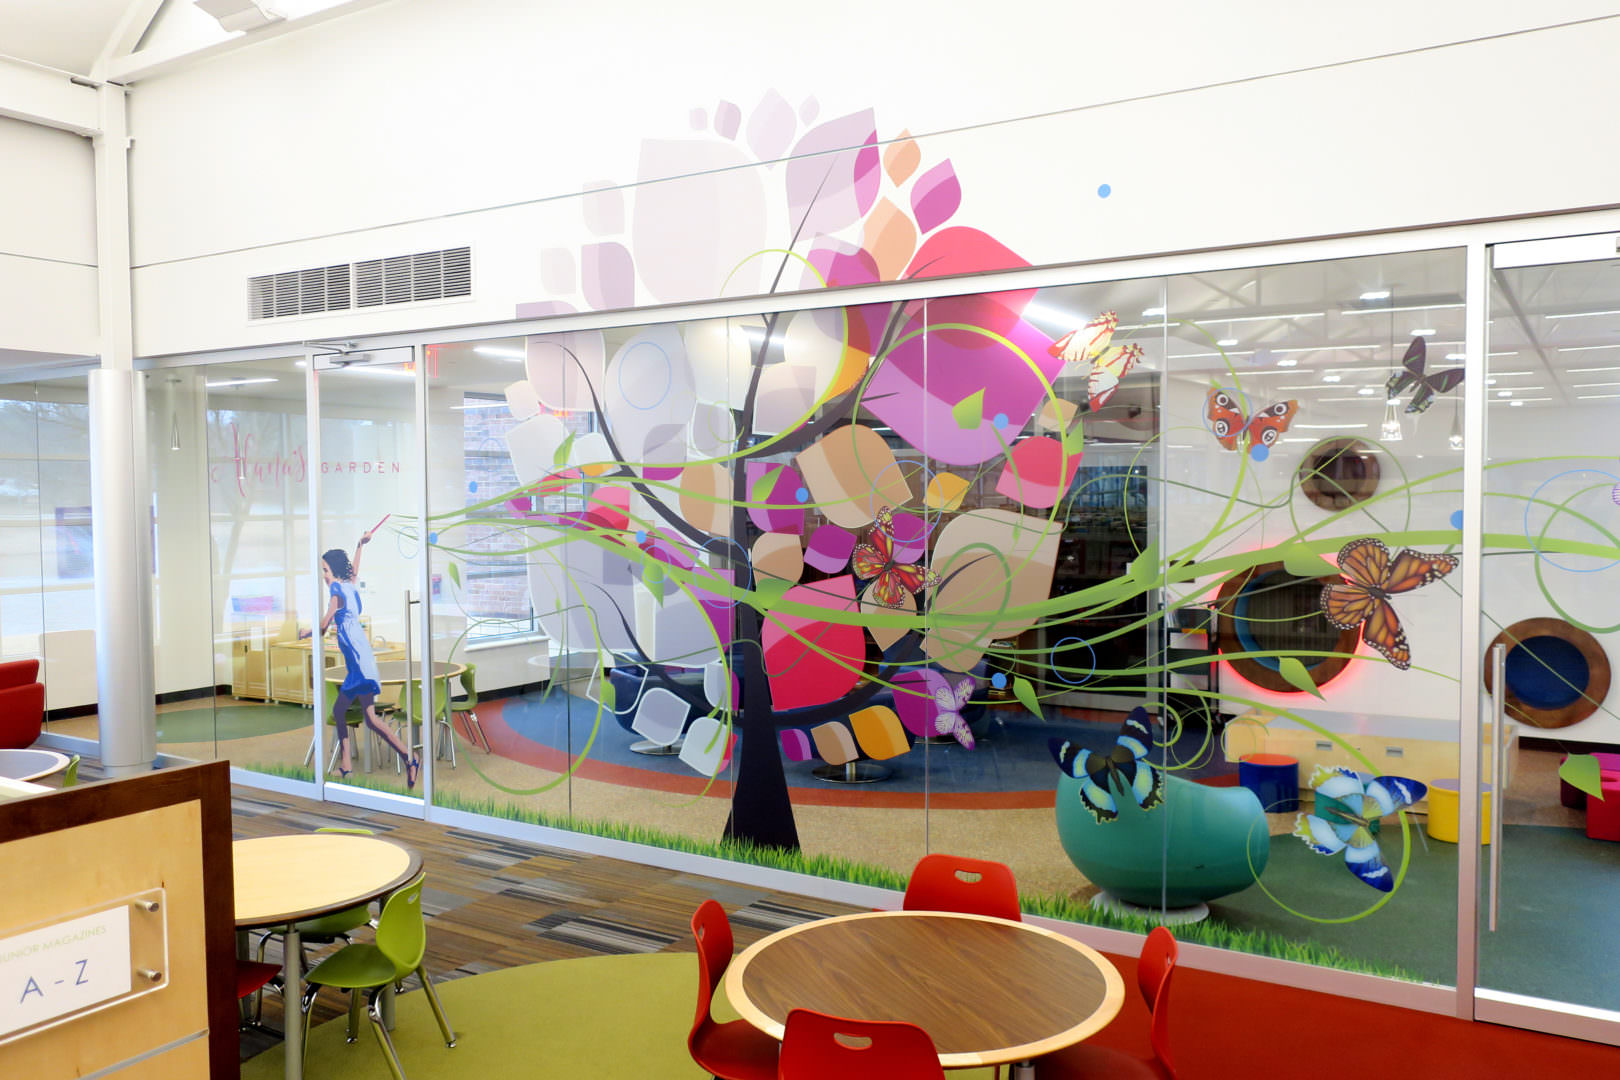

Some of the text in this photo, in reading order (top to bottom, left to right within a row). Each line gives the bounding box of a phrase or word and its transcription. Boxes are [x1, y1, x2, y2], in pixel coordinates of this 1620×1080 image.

[321, 461, 400, 474] GARDEN
[42, 925, 107, 951] MAGAZINES
[20, 976, 44, 1004] A
[75, 958, 89, 986] Z
